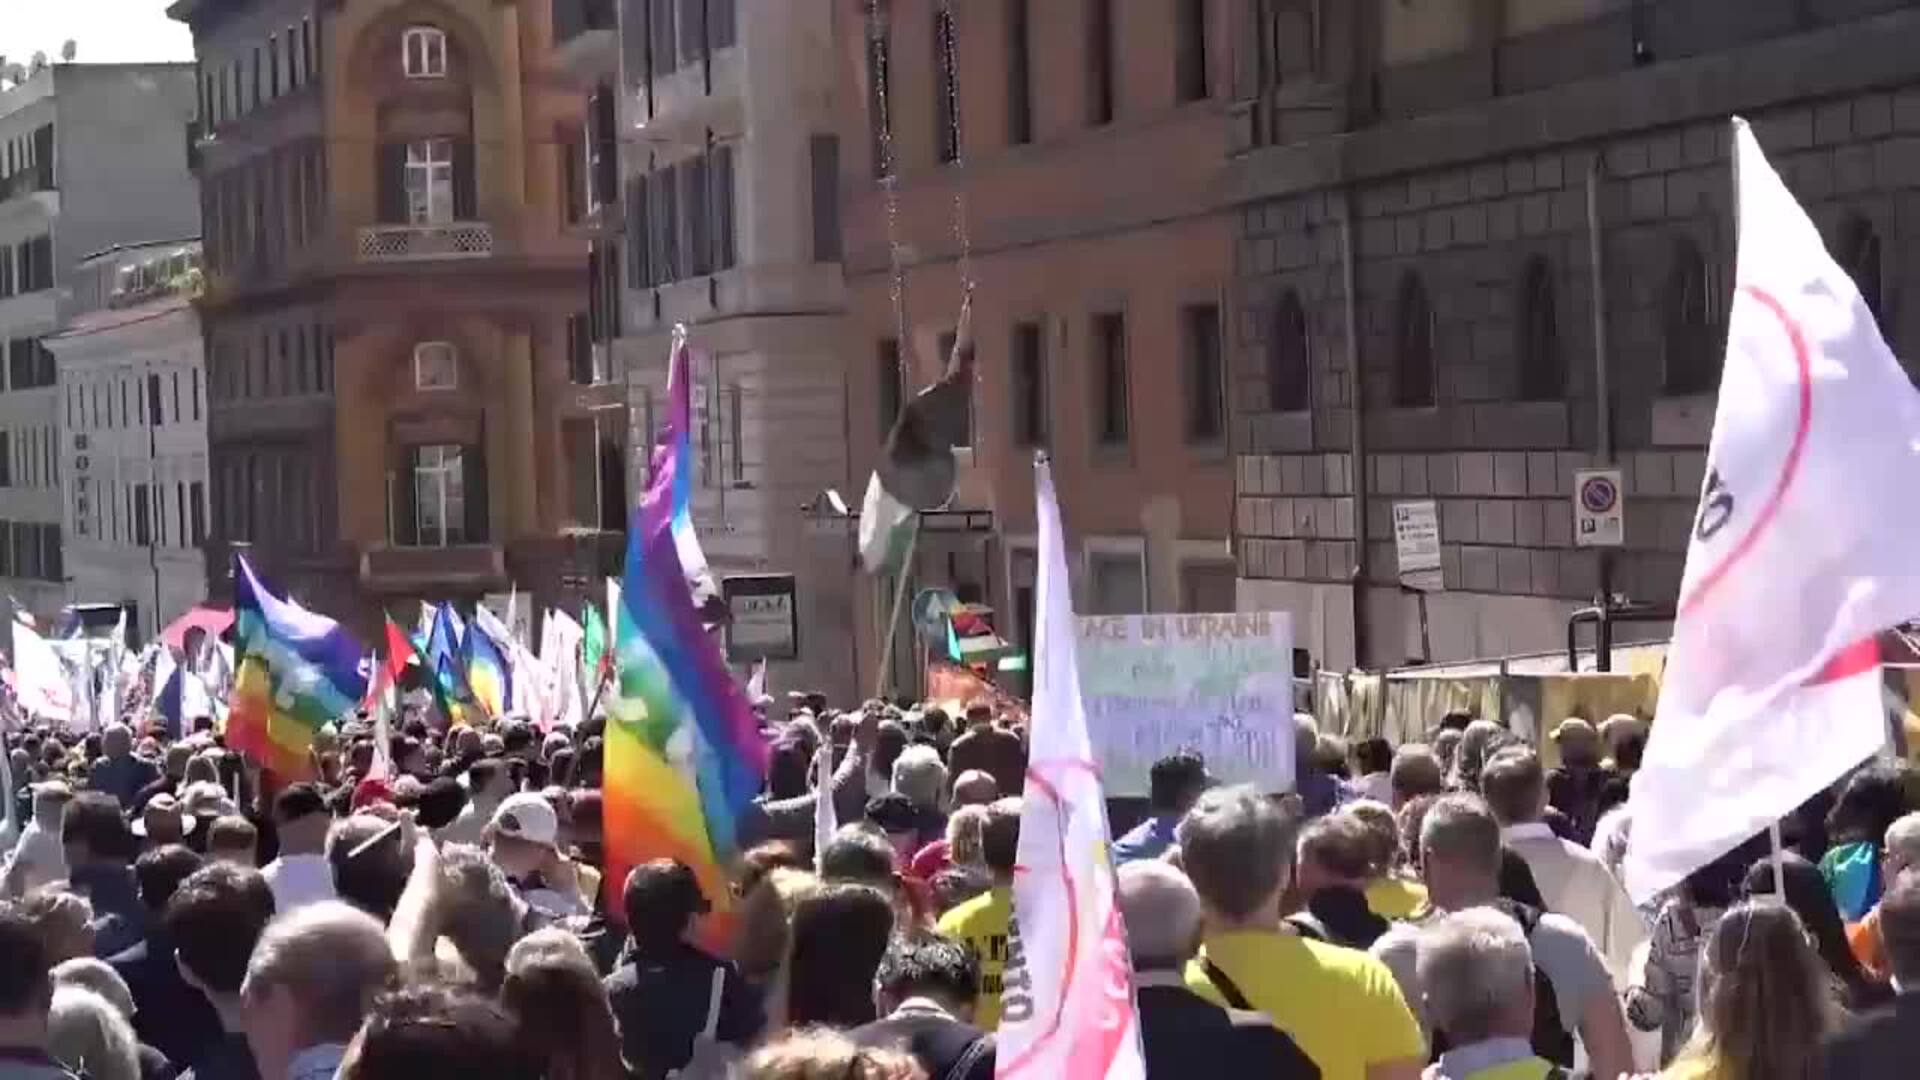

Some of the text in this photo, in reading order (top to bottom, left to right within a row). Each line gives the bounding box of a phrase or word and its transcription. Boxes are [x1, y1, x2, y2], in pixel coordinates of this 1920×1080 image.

[74, 434, 90, 535] HOTEL
[1079, 616, 1128, 639] ACE
[1141, 616, 1167, 639] IN
